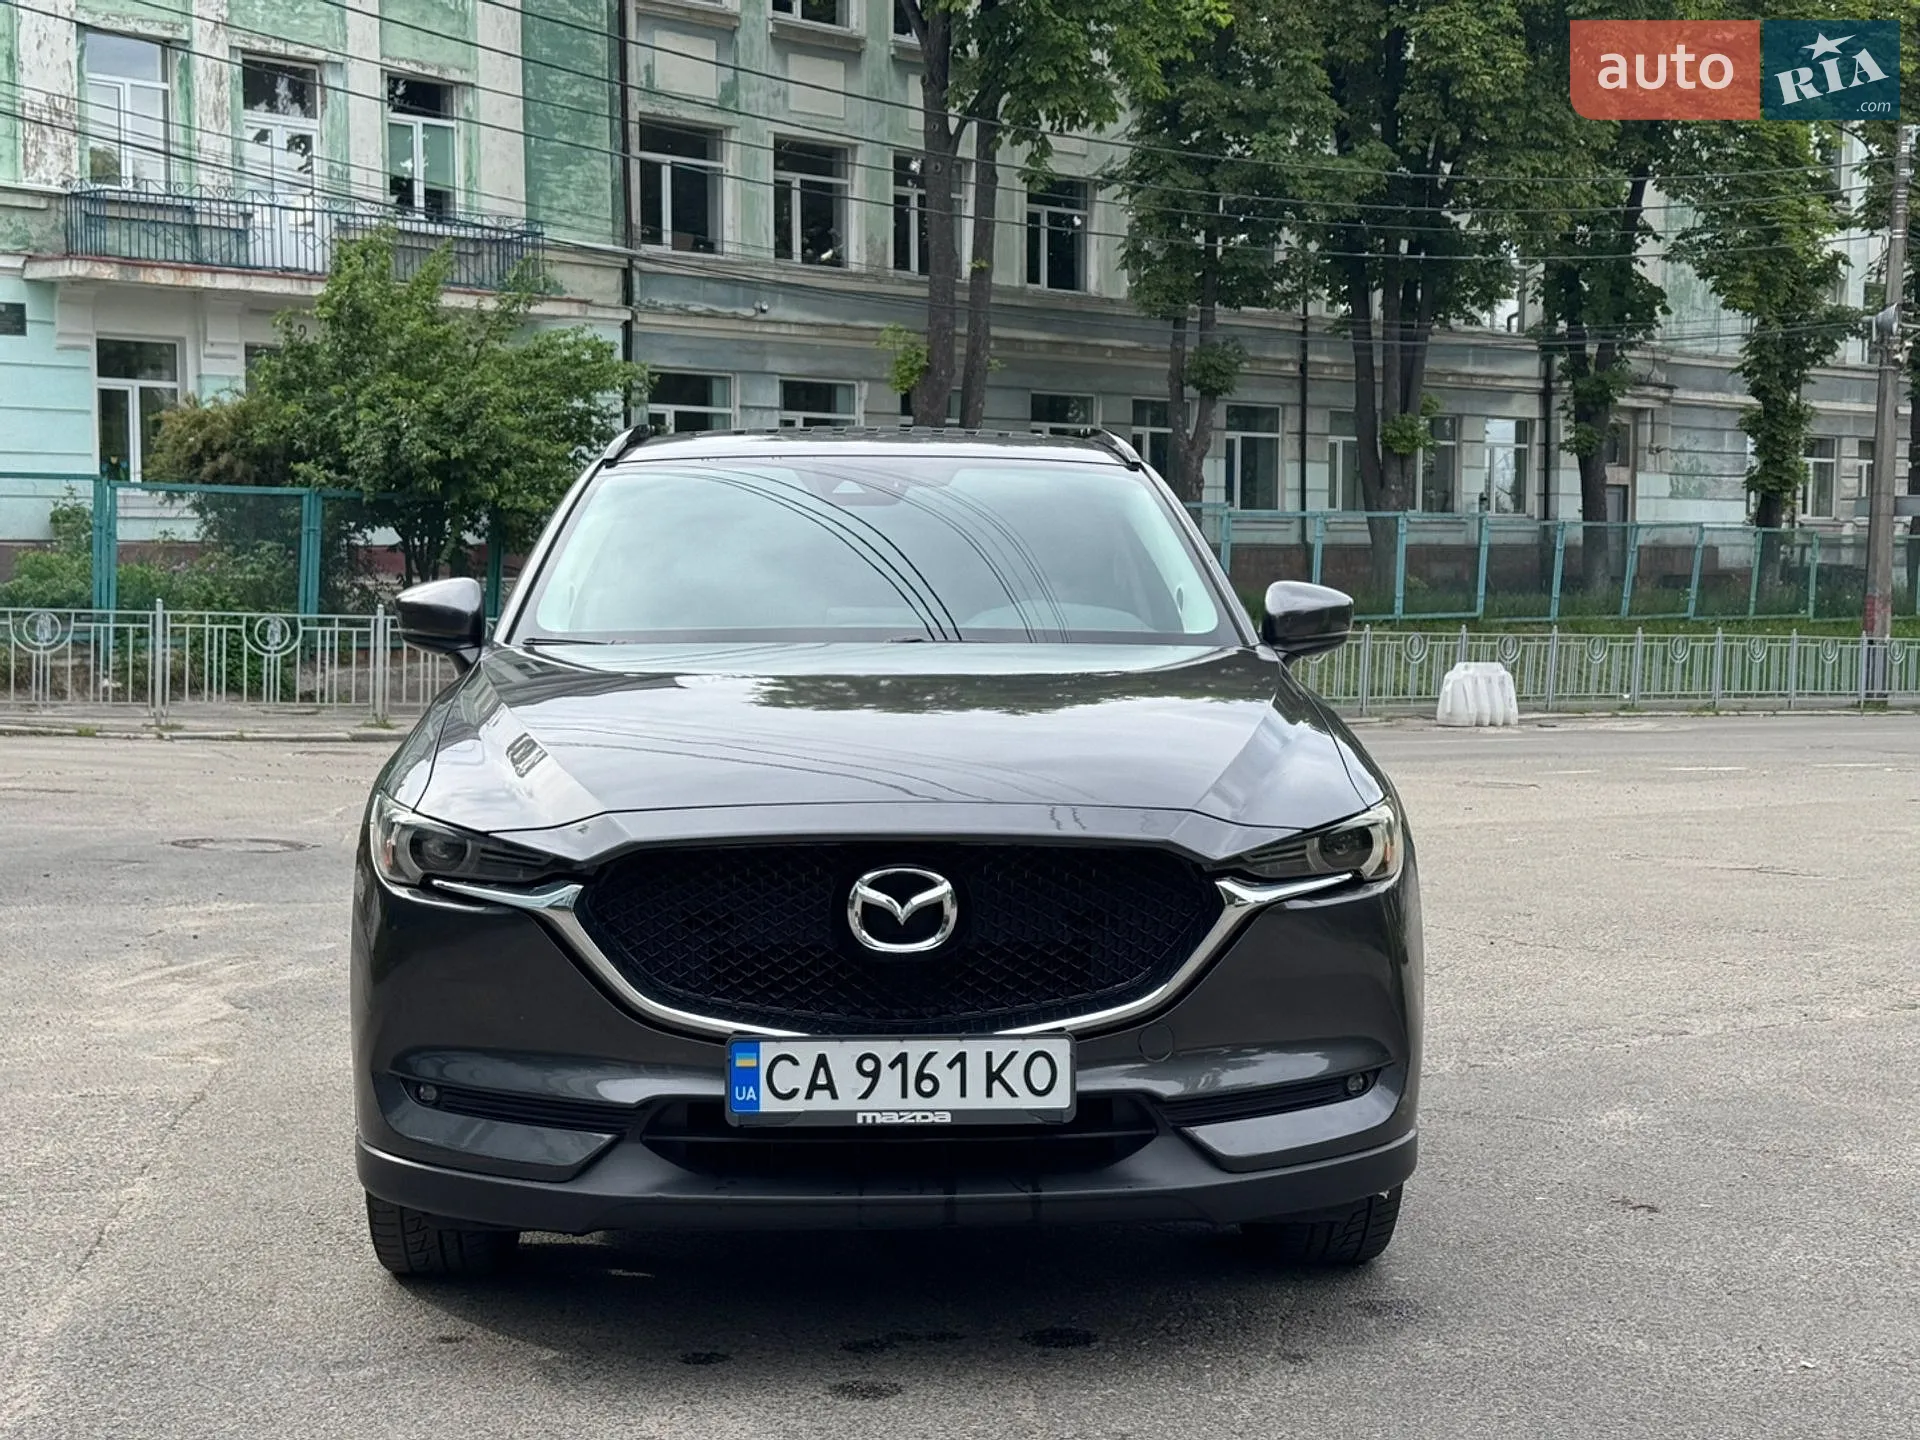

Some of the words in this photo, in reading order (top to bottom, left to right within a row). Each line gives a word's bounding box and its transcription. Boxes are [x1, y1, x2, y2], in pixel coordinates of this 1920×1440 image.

[765, 1053, 839, 1101] CA
[855, 1051, 967, 1100] 9161
[986, 1050, 1058, 1099] KO
[735, 1086, 757, 1101] UA
